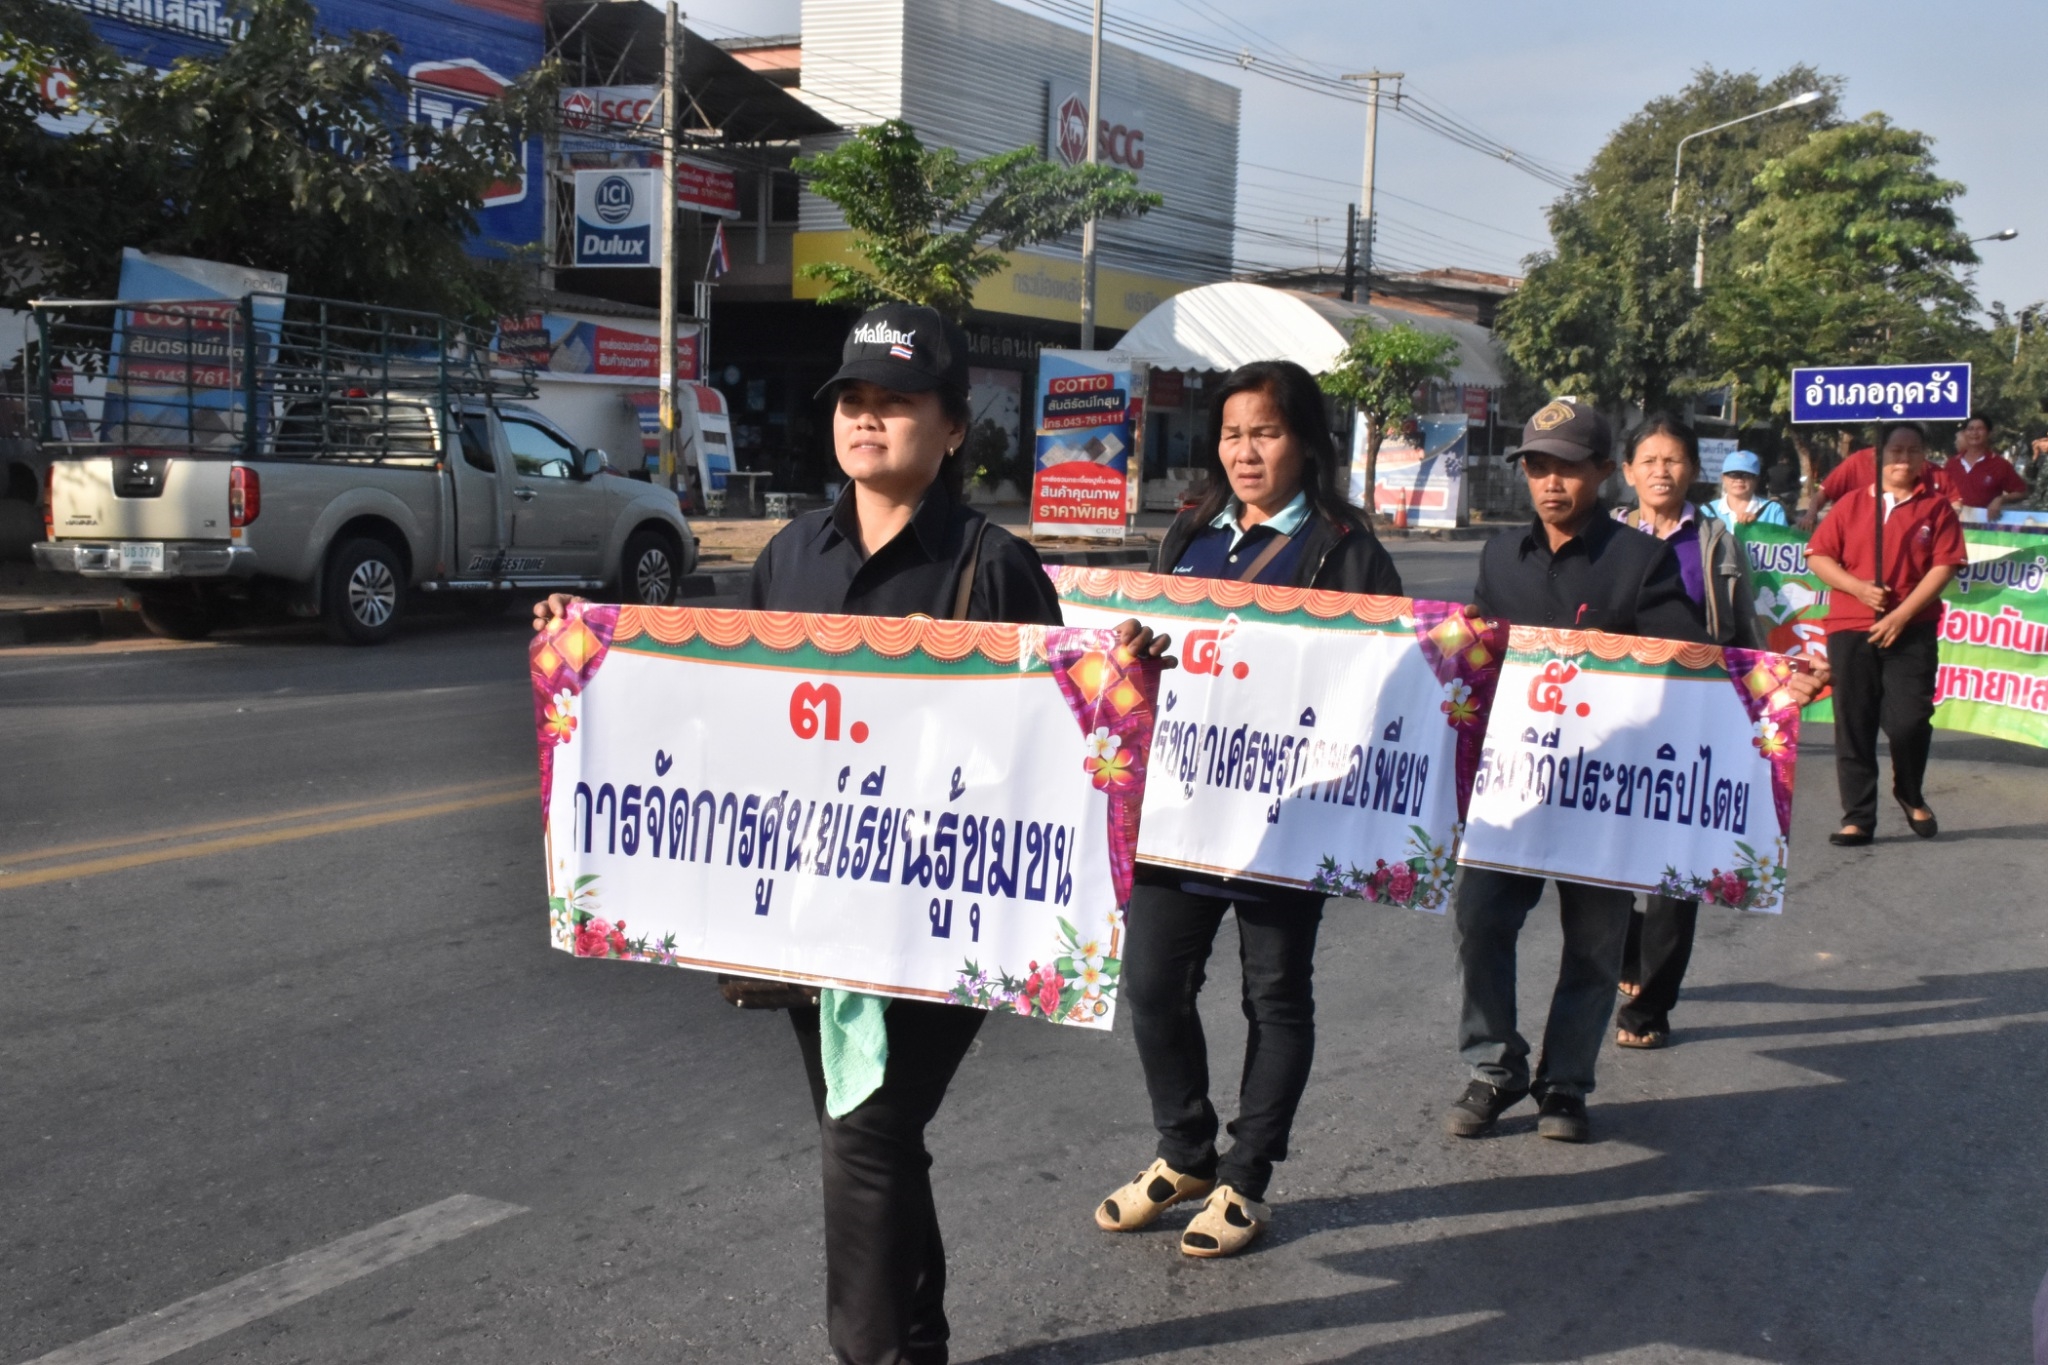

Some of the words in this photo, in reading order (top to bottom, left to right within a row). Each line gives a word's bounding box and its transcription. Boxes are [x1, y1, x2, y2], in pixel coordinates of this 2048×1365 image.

[601, 99, 653, 125] SCG
[1098, 119, 1144, 169] SCG
[602, 185, 626, 204] ICI
[582, 234, 645, 255] Dulux
[144, 303, 241, 327] COTTO
[1055, 376, 1108, 393] COTTO
[1806, 371, 1958, 415] อำเภอกุดรัง
[1041, 485, 1120, 502] สินค้าคุณภาพ
[1040, 503, 1120, 520] ราคาพิเศษ
[1096, 527, 1122, 536] COTTO
[468, 555, 545, 571] BRIGESTONE
[789, 682, 870, 744] ๓.
[1154, 690, 1429, 824] รัชญาเศรษฐกิจพอเพียง
[574, 749, 1076, 943] การจัดการศูนย์เรียนรู้ชุมชน
